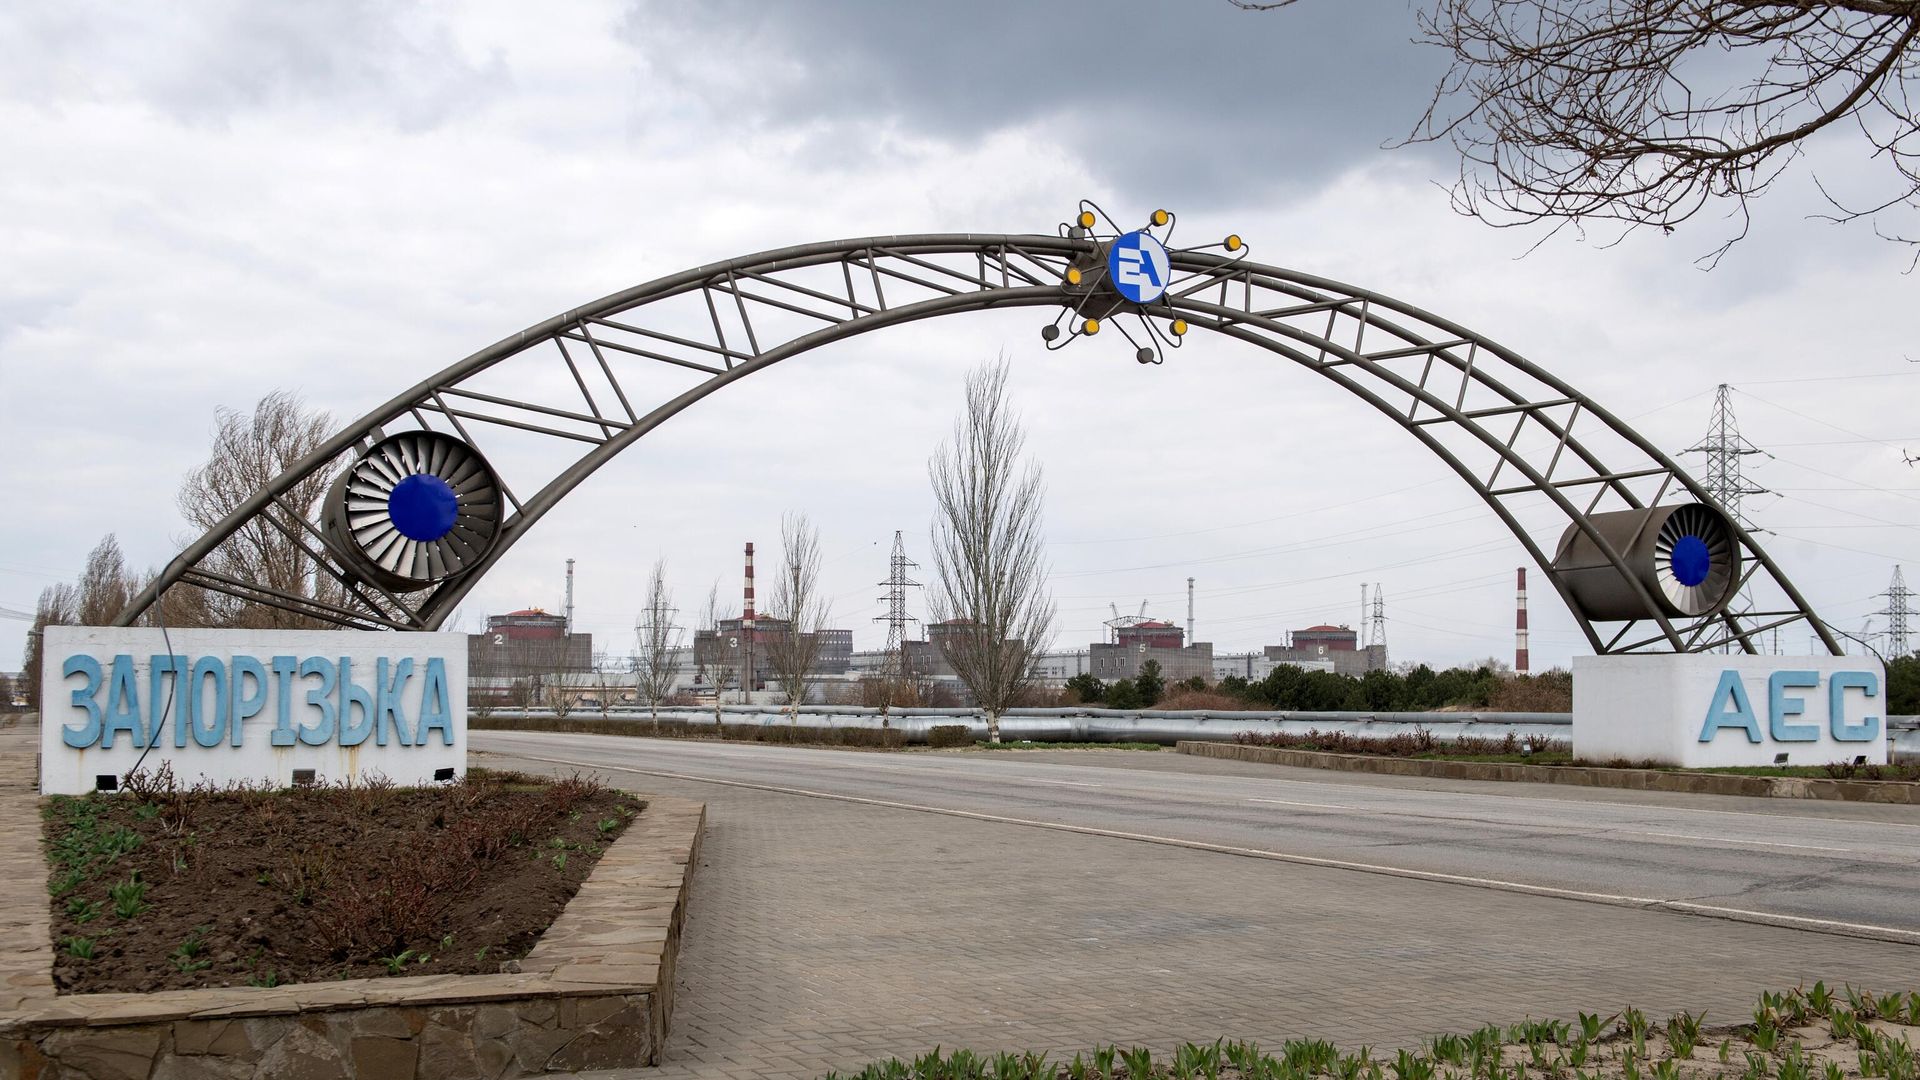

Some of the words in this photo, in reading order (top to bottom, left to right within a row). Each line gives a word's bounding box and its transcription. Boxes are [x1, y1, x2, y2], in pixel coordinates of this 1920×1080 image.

[494, 634, 503, 645] 2
[729, 637, 738, 648] 3
[1139, 643, 1146, 653] 5
[1318, 645, 1324, 655] 6
[63, 654, 454, 749] ЗАПОРІЗЬКА
[1698, 670, 1879, 743] АЕС
